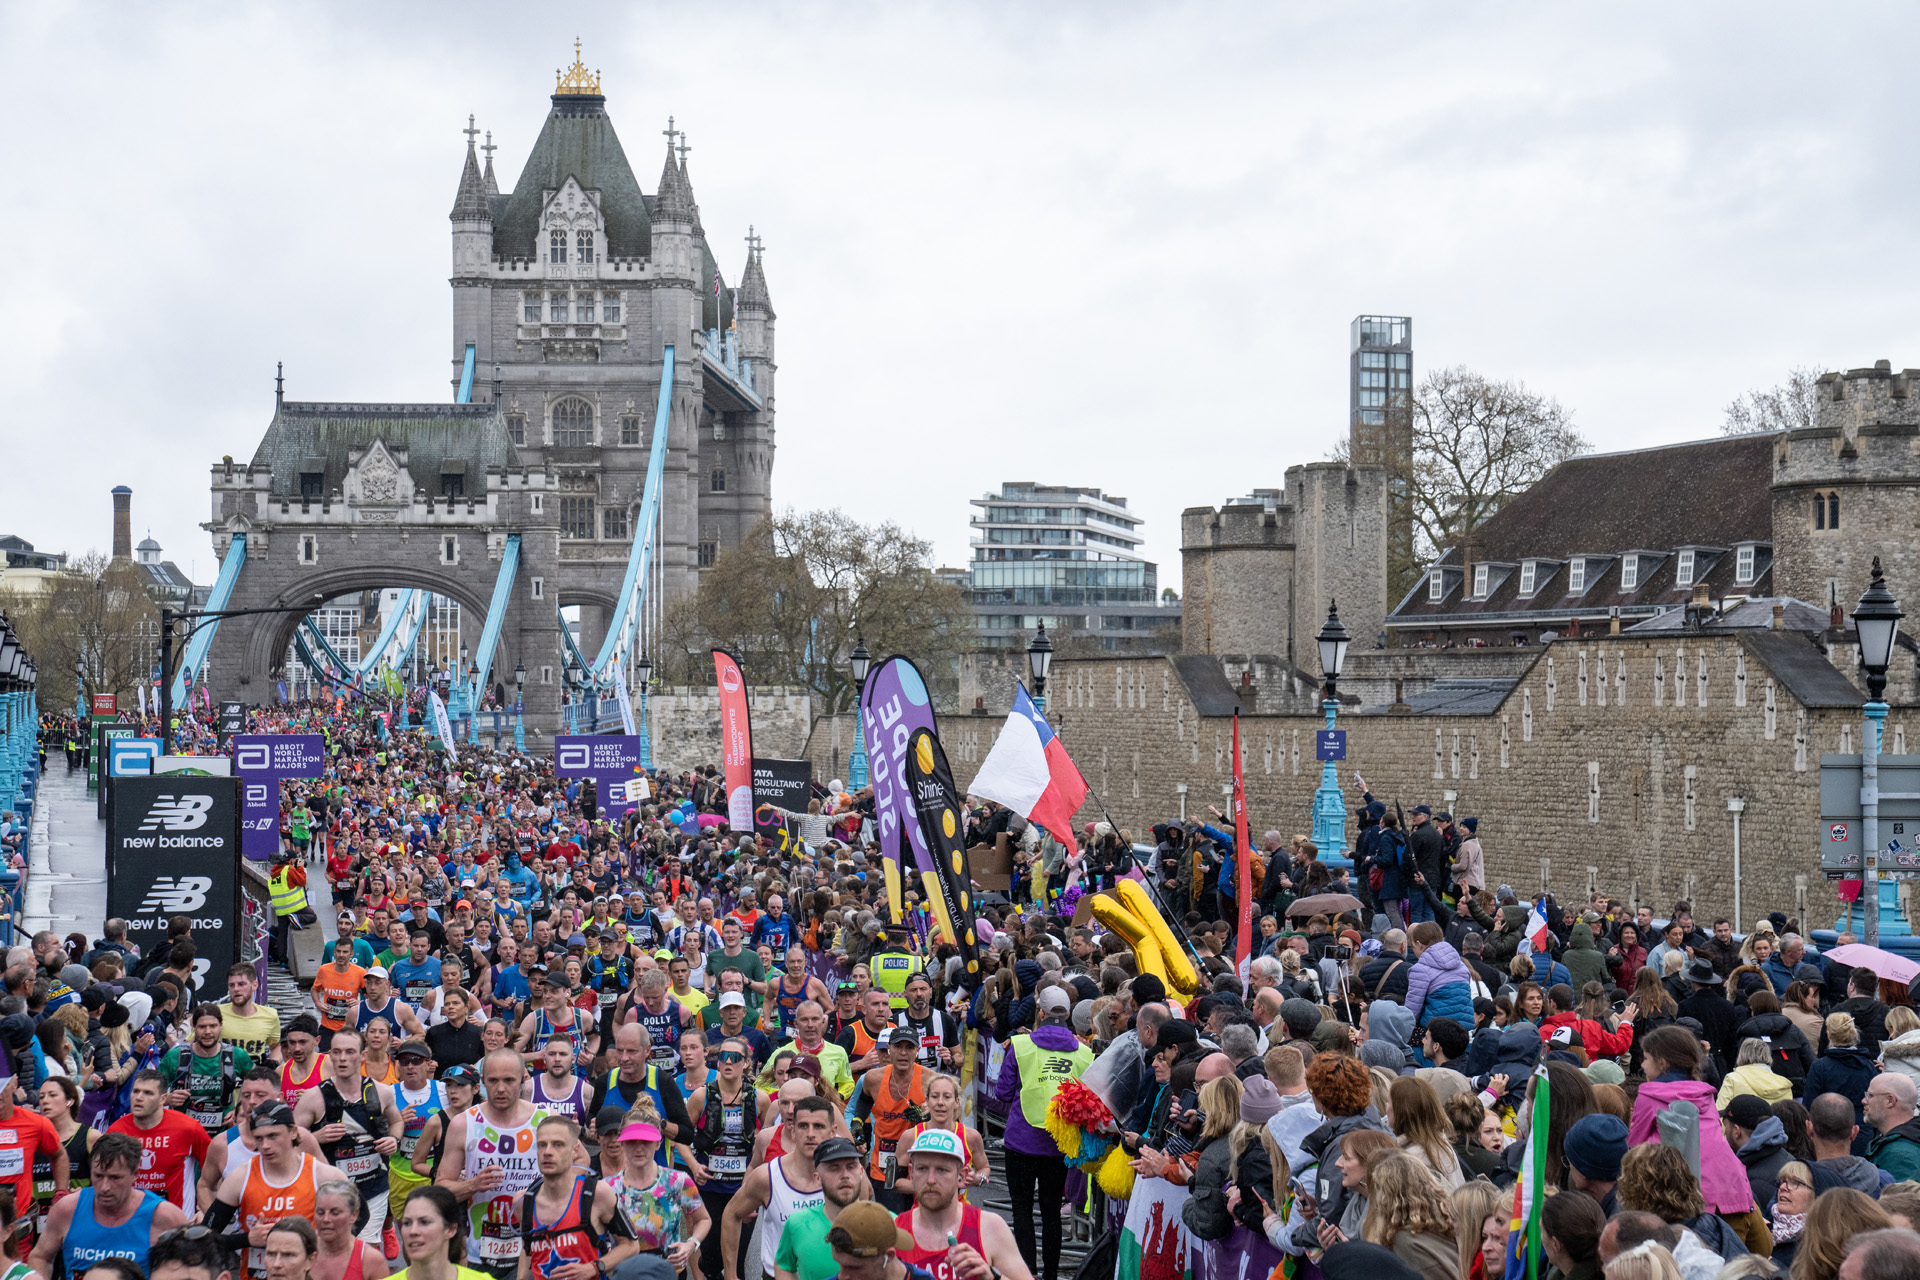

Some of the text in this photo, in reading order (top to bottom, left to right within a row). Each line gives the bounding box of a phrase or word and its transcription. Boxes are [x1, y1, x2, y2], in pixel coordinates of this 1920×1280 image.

[754, 769, 774, 778] ATA
[754, 778, 805, 789] ONSULTANCY
[917, 779, 944, 800] Shine
[754, 787, 784, 797] ERVICES
[138, 795, 214, 831] NB
[123, 835, 224, 848] new balance
[136, 876, 213, 913] NB
[125, 919, 154, 930] new
[884, 959, 908, 967] POLICE
[644, 1015, 670, 1025] DOLLY
[1041, 1056, 1073, 1074] NB
[347, 1158, 371, 1172] 8943
[478, 1157, 536, 1170] FAMILY
[714, 1159, 741, 1170] 35489
[134, 1180, 165, 1189] hildren
[262, 1196, 295, 1212] JOE
[73, 1247, 136, 1261] RICHARD
[487, 1241, 518, 1256] 12425
